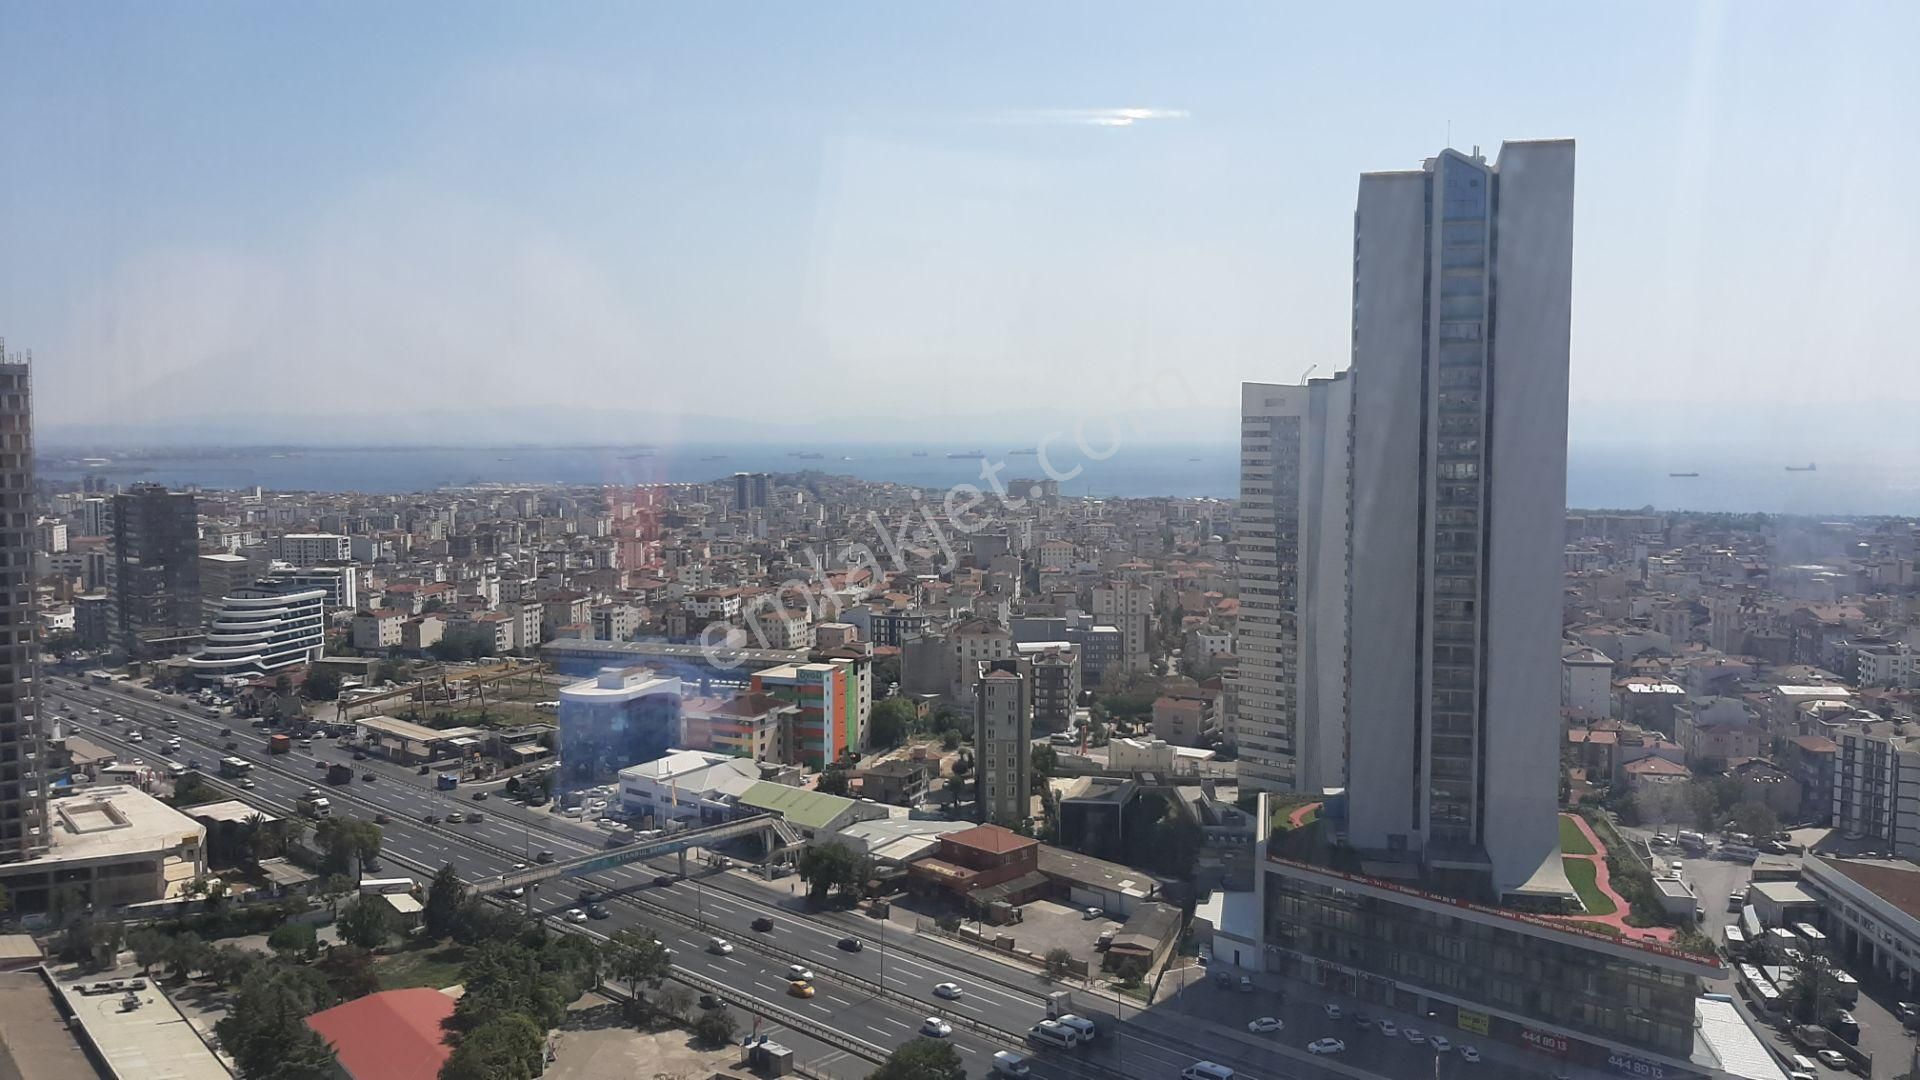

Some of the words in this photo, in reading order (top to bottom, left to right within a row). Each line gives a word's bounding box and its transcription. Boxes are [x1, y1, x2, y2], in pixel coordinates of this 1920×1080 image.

[1521, 1031, 1540, 1044] 444
[1557, 1039, 1567, 1052] 13
[1608, 1055, 1631, 1070] 444
[1633, 1062, 1649, 1074] 89
[1652, 1067, 1663, 1079] 13
